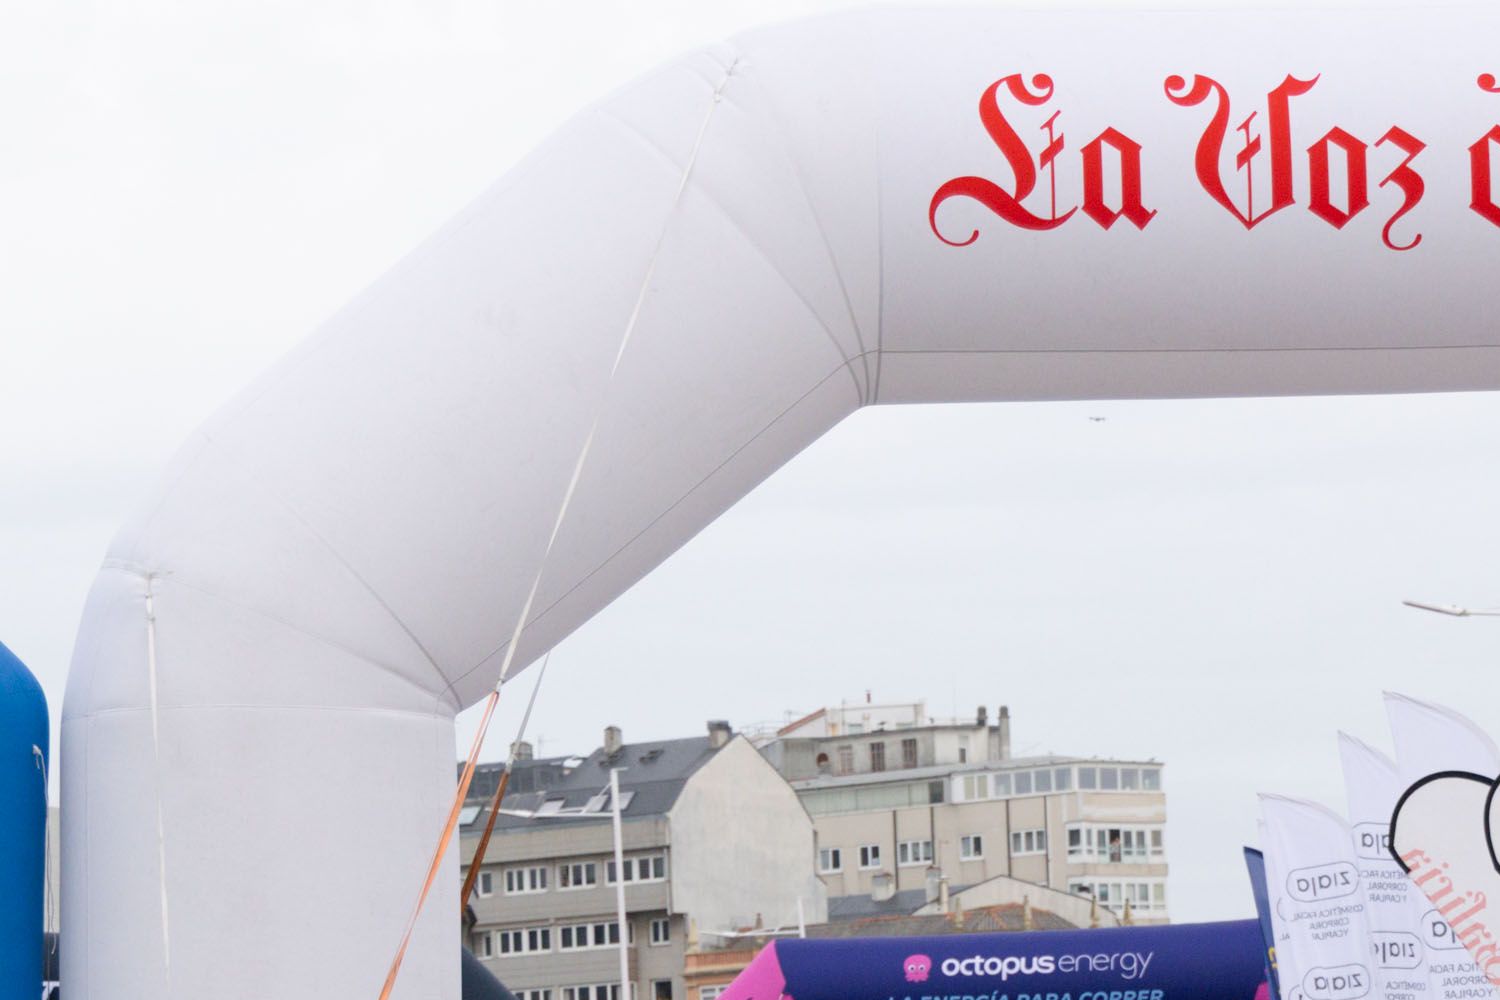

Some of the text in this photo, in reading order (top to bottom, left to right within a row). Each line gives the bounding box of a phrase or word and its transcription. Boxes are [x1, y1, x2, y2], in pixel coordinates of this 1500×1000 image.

[929, 73, 1156, 247] La
[1164, 74, 1426, 251] Voz
[941, 952, 1153, 981] octopus energy
